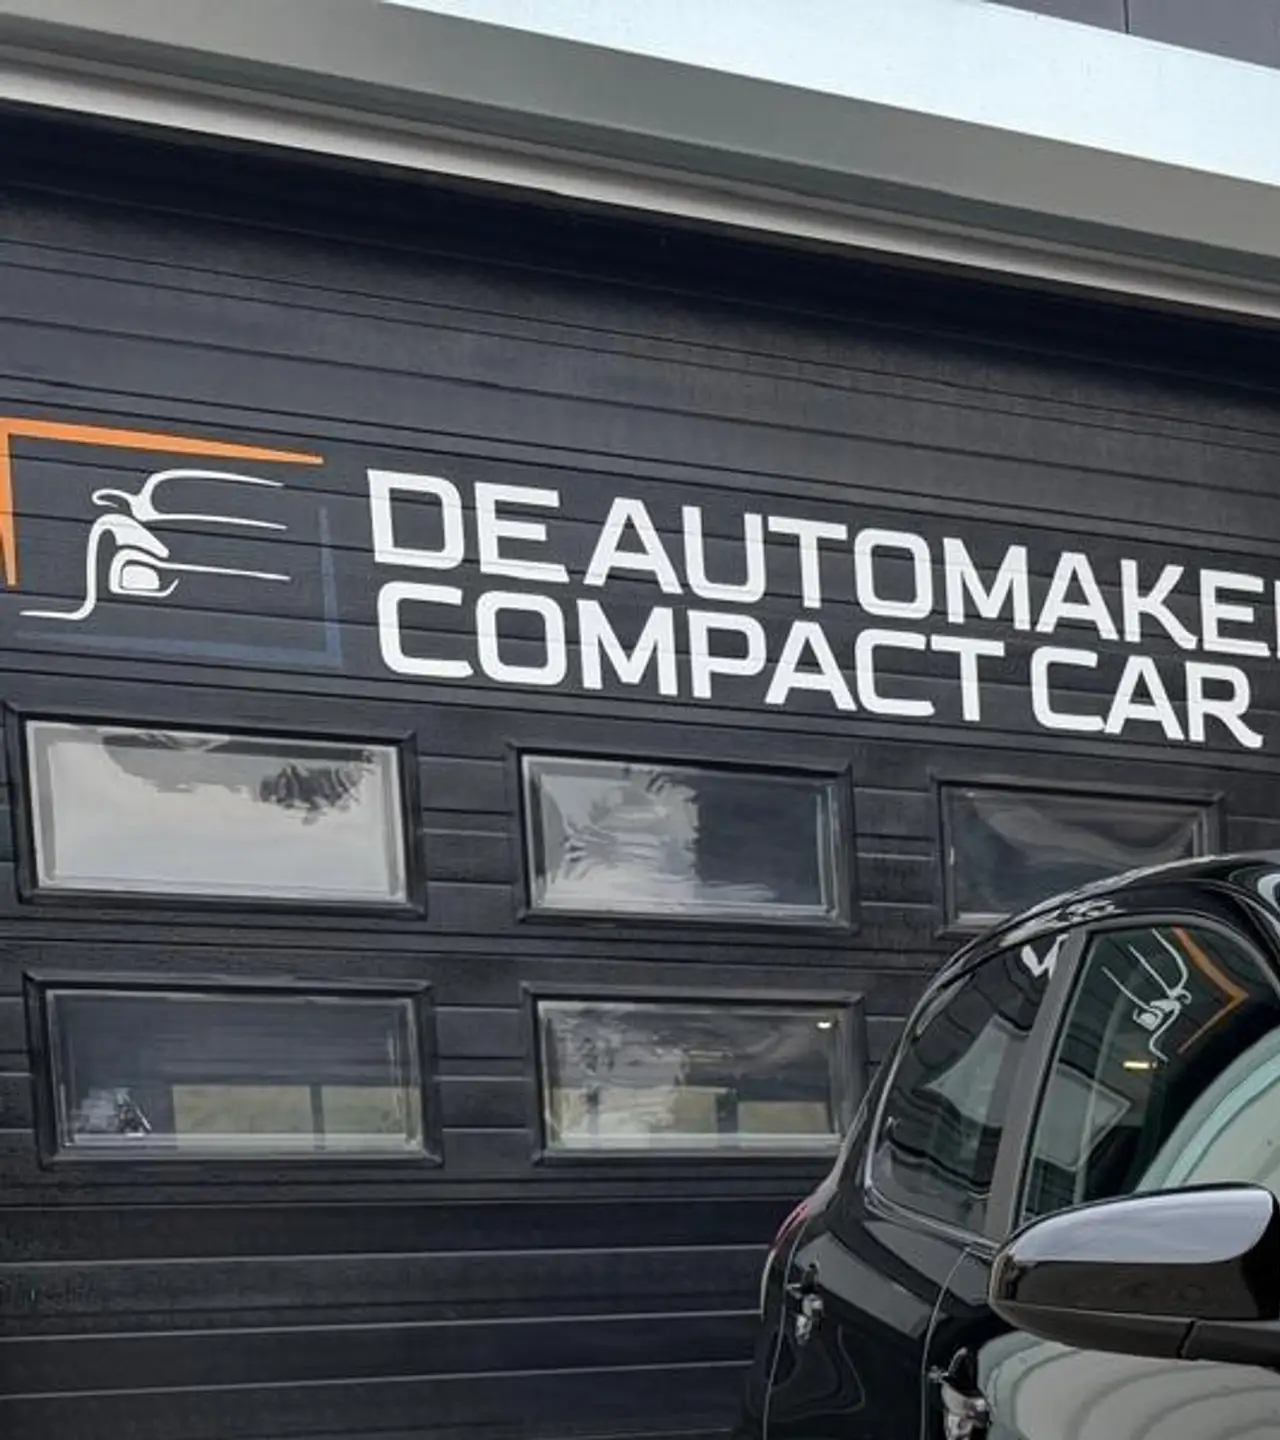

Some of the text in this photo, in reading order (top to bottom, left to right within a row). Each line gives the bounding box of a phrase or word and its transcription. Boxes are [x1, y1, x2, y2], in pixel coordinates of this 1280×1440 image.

[367, 467, 569, 583] DE
[378, 582, 1263, 748] COMPACT CAR
